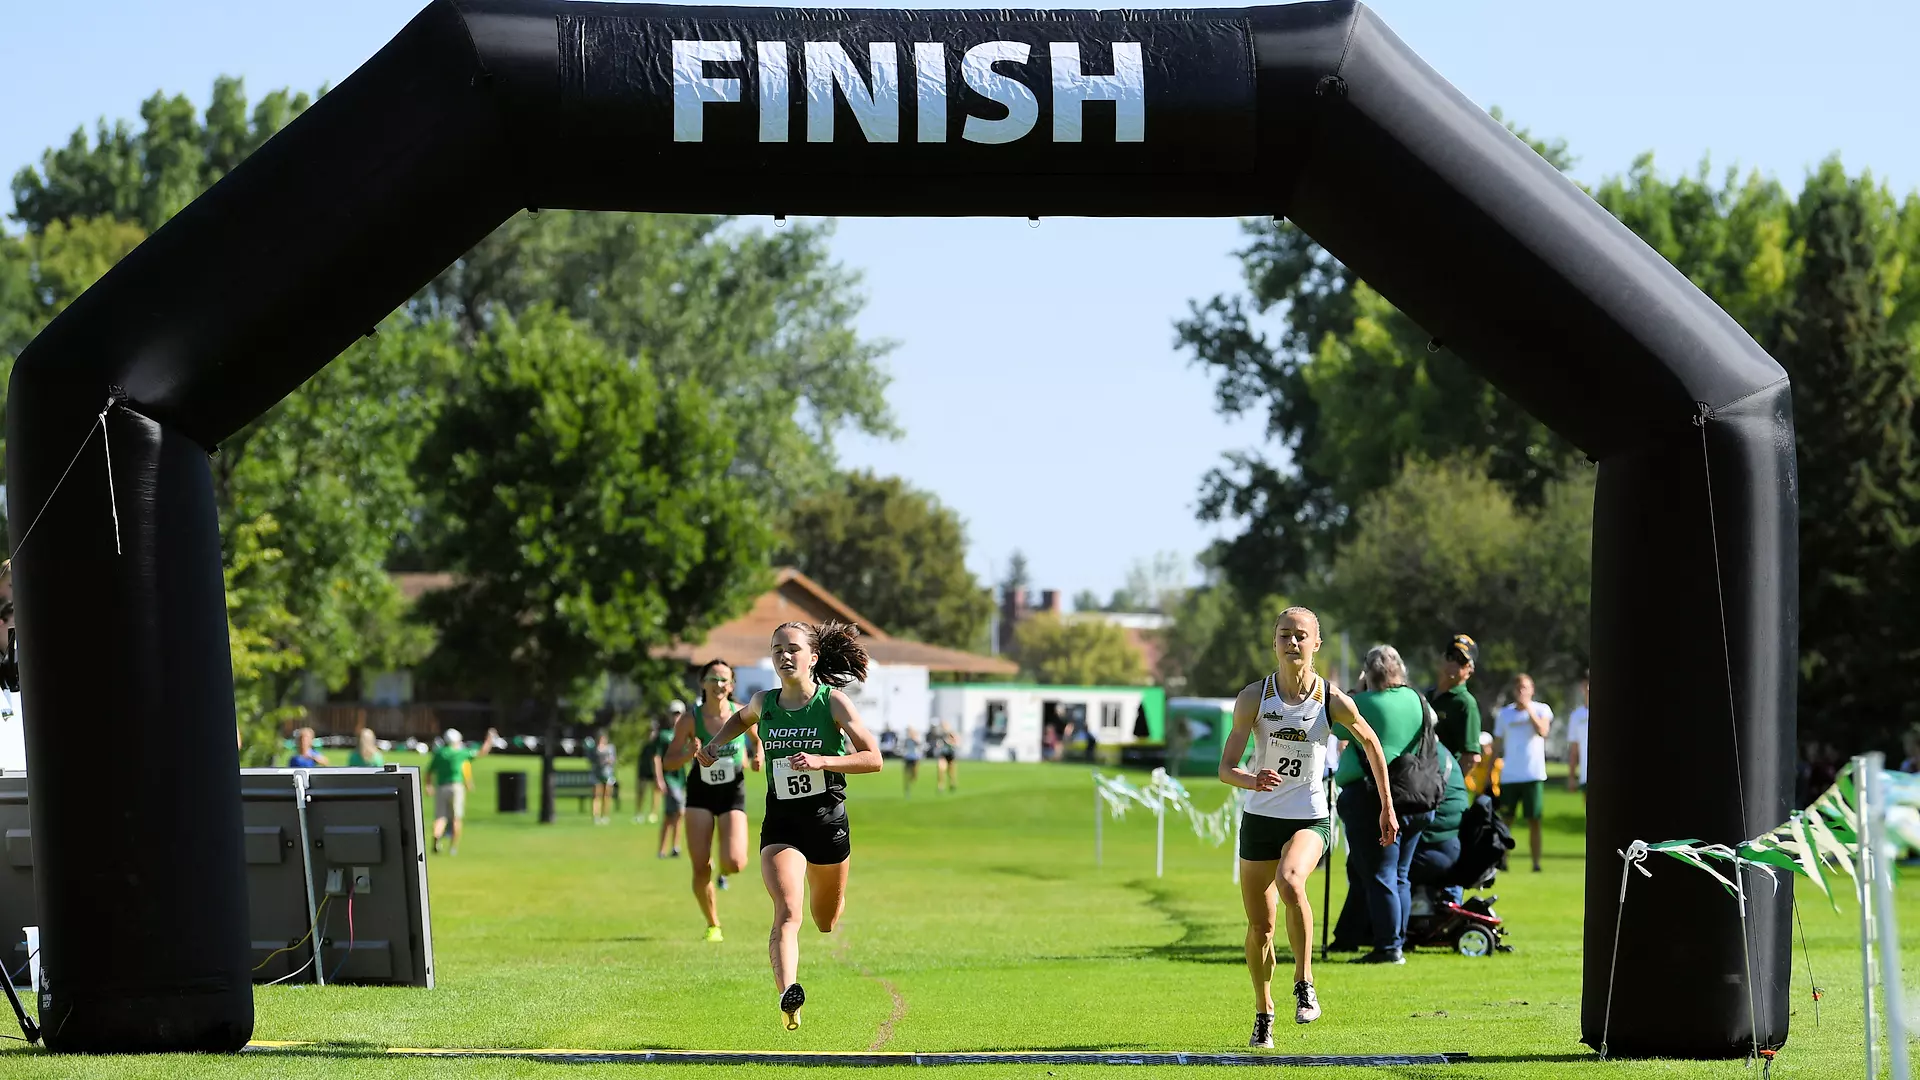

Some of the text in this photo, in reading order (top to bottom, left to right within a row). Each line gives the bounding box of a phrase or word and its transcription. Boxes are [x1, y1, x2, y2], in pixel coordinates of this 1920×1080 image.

[671, 40, 1145, 144] FINISH
[768, 727, 818, 738] NORTH
[764, 739, 823, 751] DAKOTA
[1277, 757, 1302, 777] 23
[710, 769, 726, 782] 59
[786, 774, 812, 796] 53
